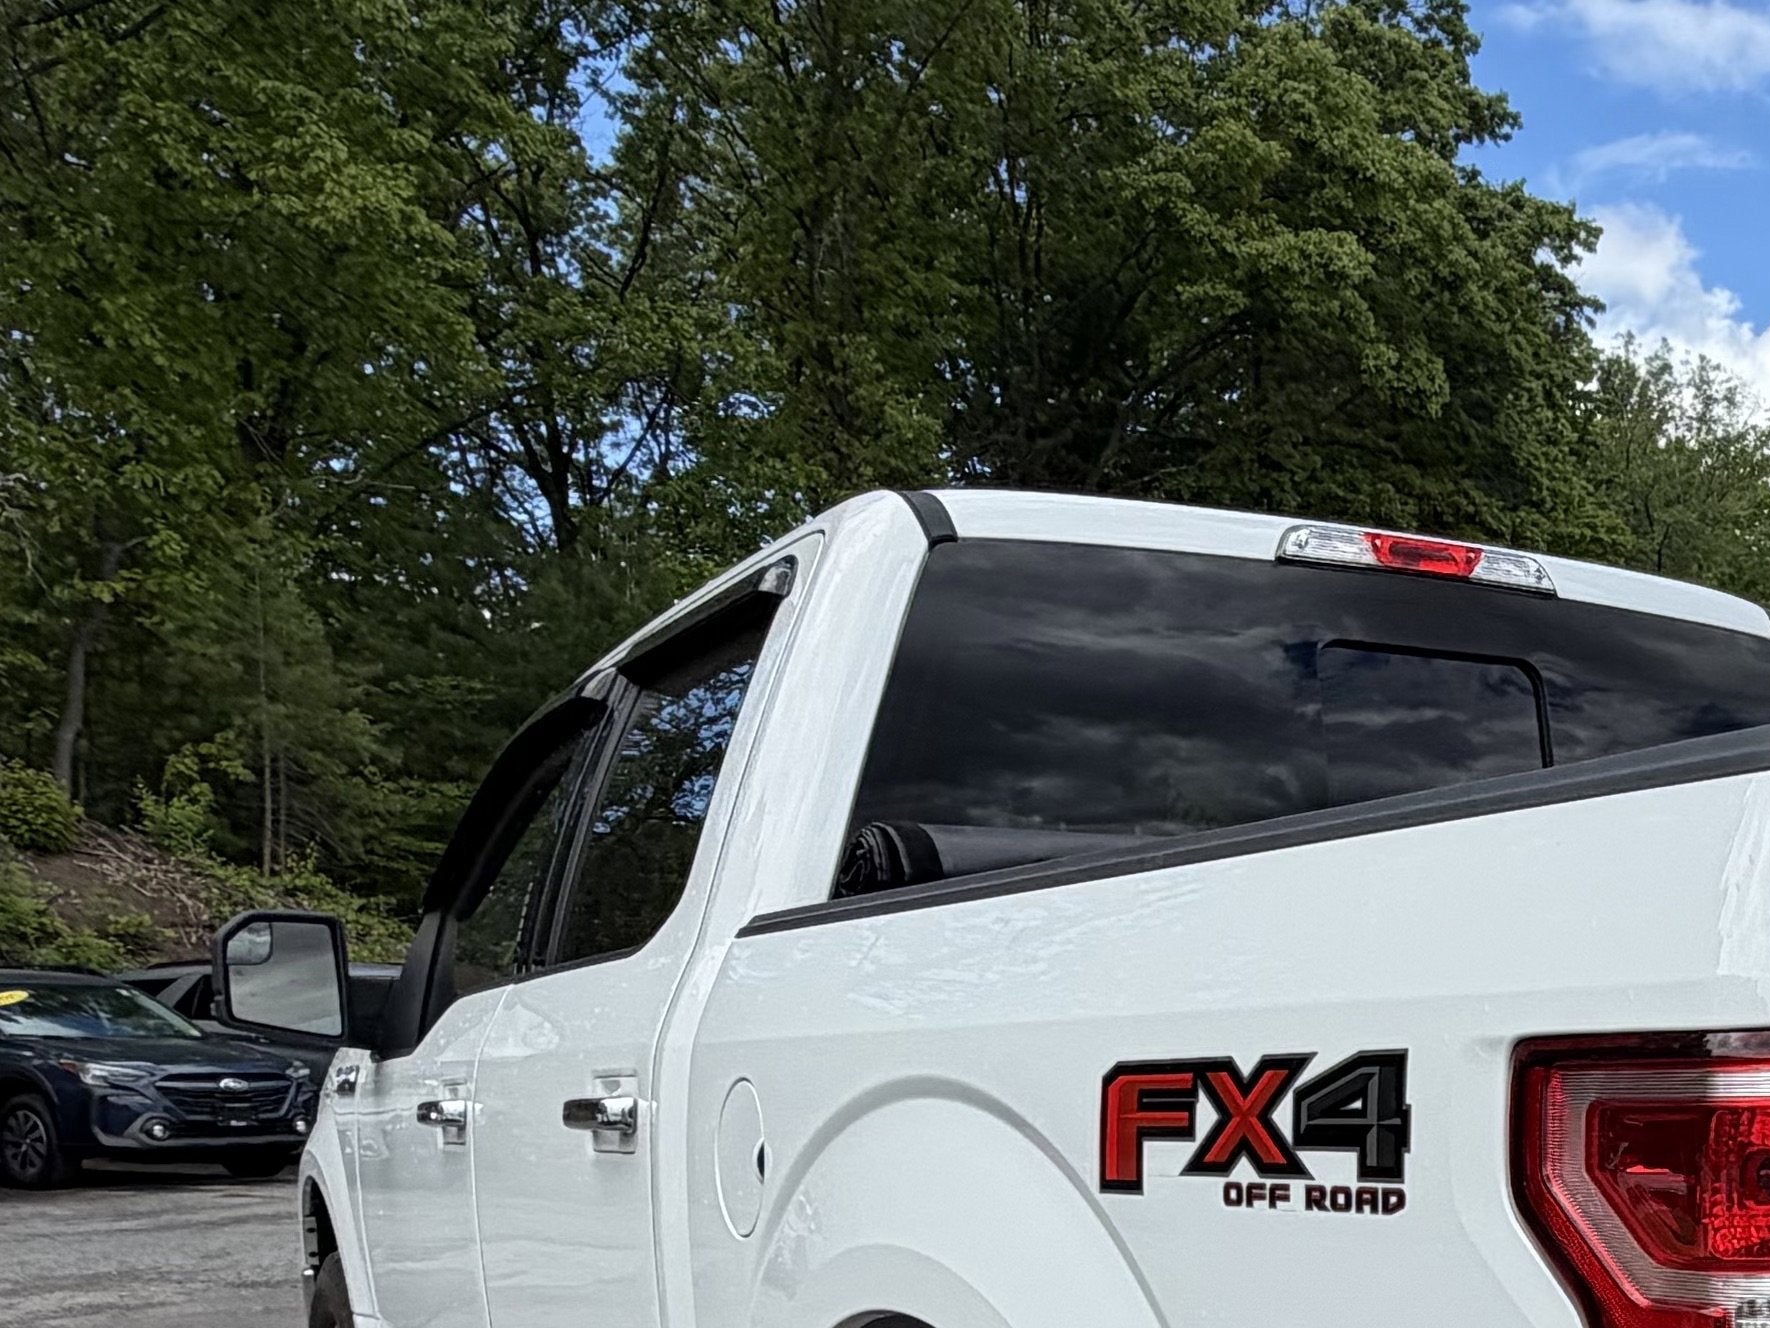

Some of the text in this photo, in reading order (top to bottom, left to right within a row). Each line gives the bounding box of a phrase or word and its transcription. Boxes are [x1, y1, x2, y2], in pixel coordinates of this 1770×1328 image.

[1100, 1048, 1411, 1195] FX4
[1222, 1181, 1407, 1216] OFF ROAD
